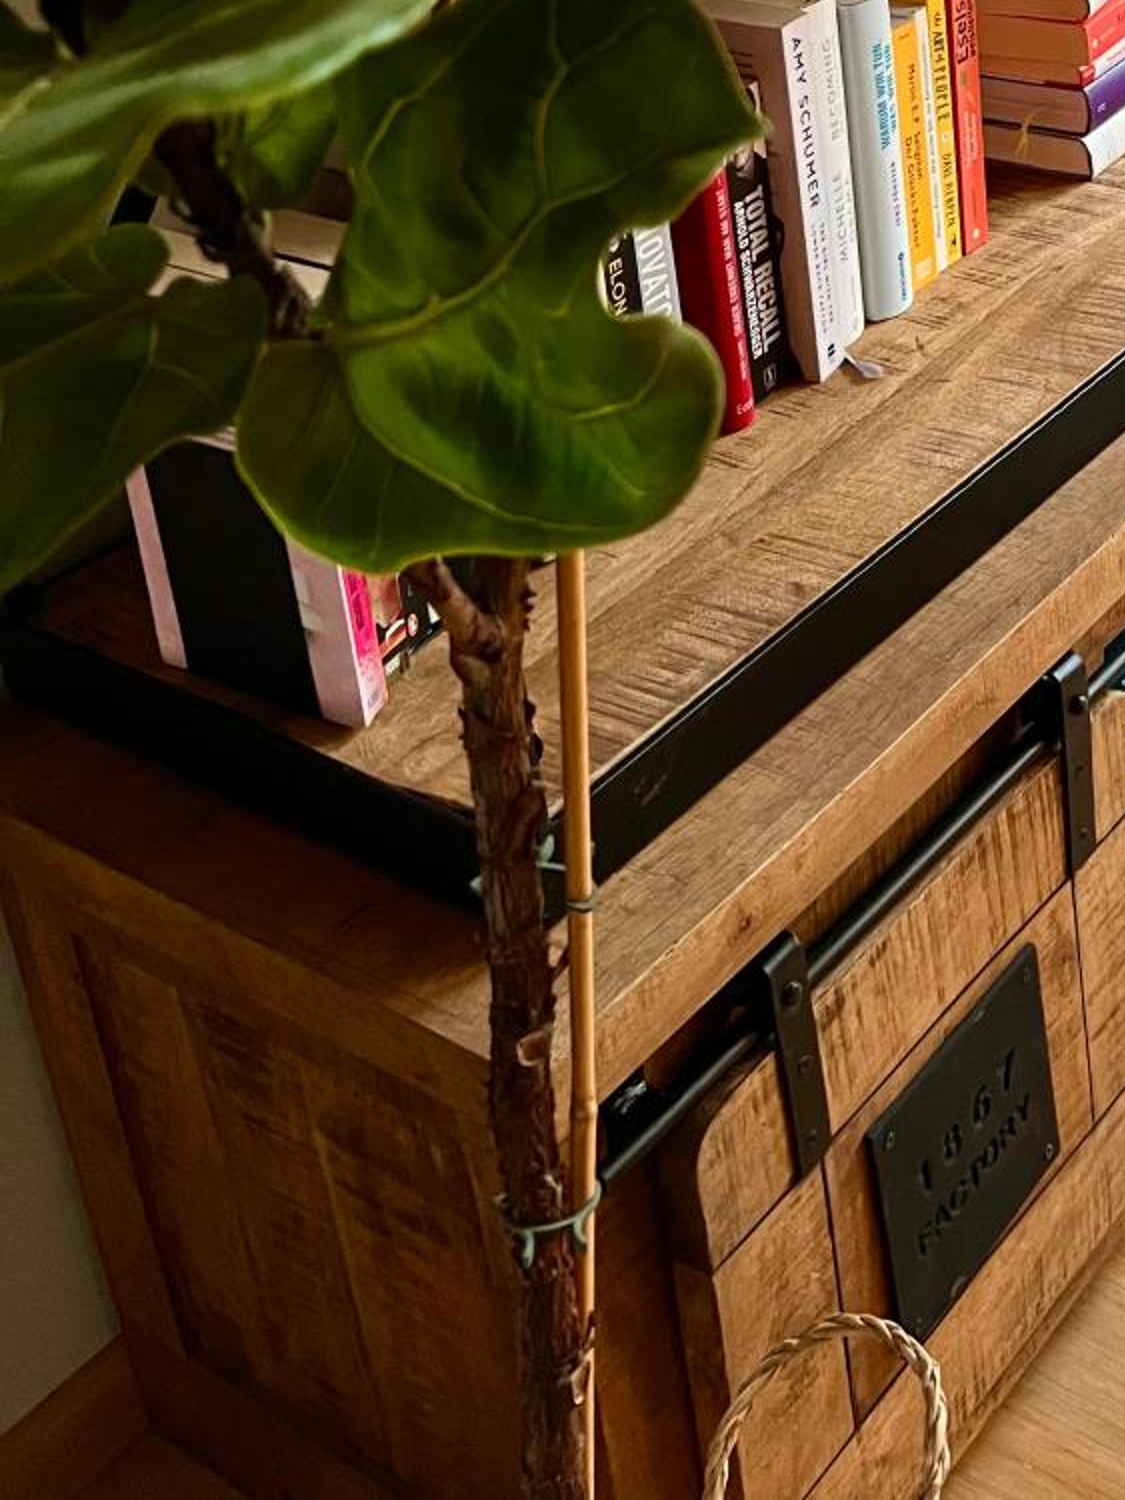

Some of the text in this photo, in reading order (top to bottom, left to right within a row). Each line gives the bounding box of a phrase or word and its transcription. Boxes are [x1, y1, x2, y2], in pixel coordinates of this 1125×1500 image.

[954, 0, 970, 65] Esels
[791, 36, 820, 209] AMY SCHUMER
[821, 38, 841, 141] BECOMING
[733, 201, 750, 249] ARNOLD
[744, 184, 782, 353] TOTAL RECALL
[832, 168, 849, 263] MICHELLE
[608, 256, 628, 317] ELON
[740, 249, 764, 360] SCHWARZENEGGER
[920, 1046, 1016, 1193] 1867
[918, 1092, 1030, 1257] FACTORY
